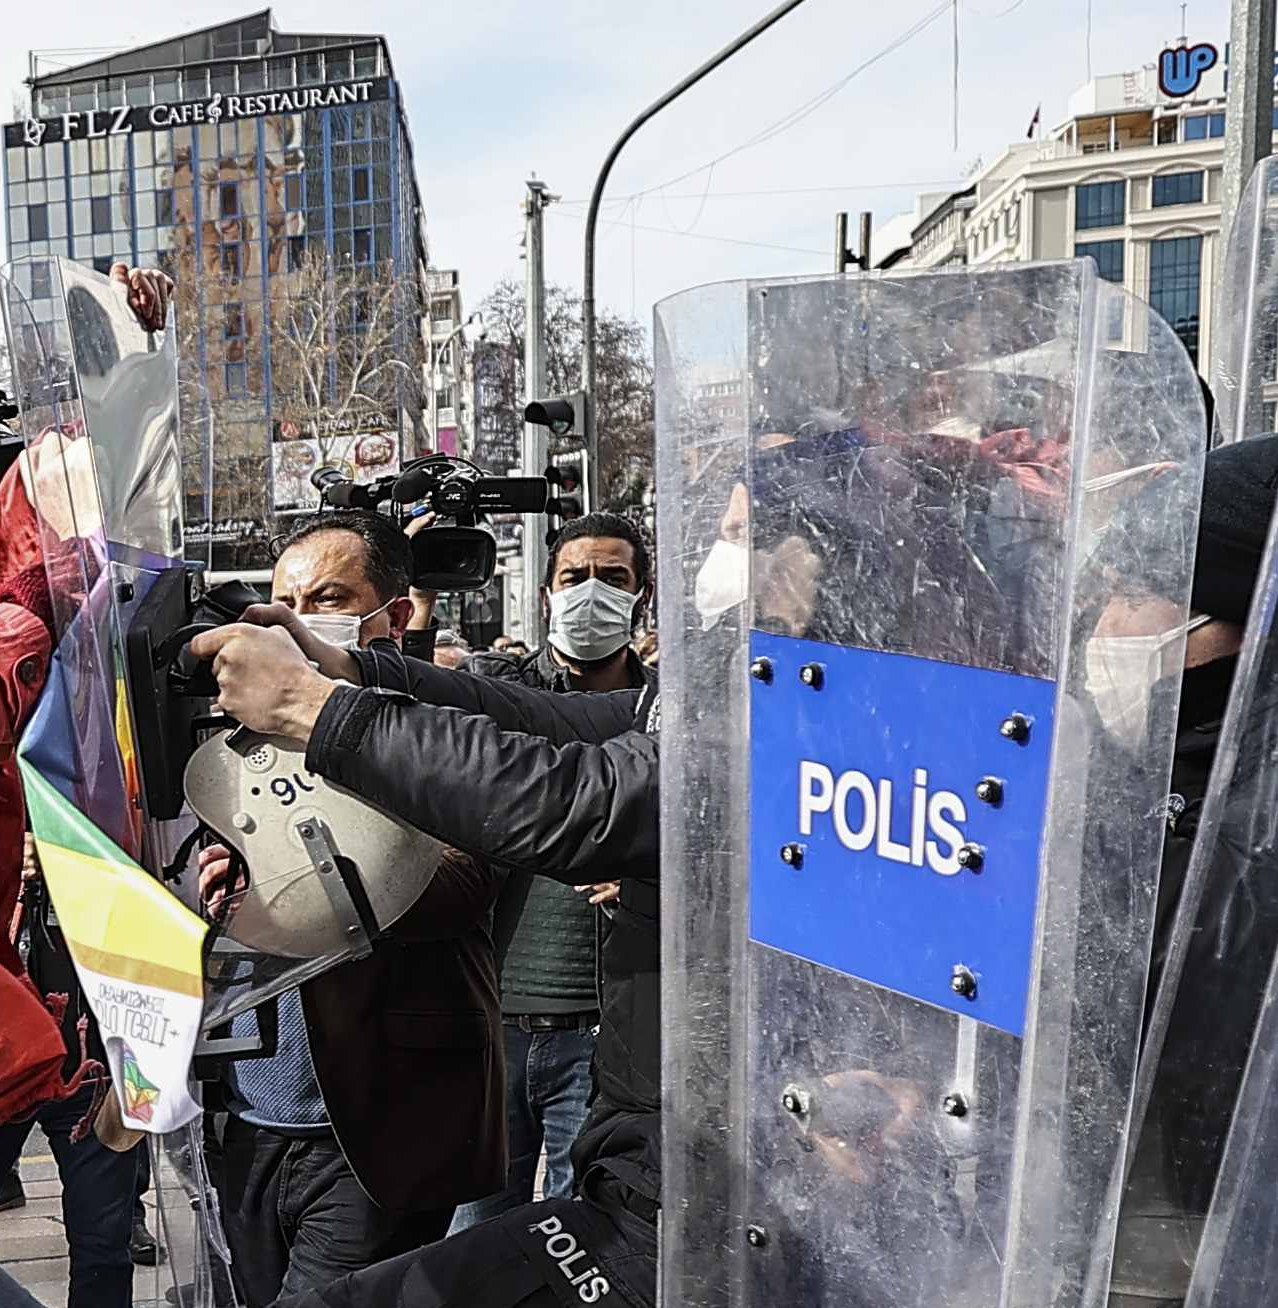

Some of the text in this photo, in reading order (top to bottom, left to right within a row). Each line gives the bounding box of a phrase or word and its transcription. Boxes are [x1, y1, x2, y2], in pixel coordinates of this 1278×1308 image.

[61, 82, 373, 140] FLZ CAFE RESTAURANT
[798, 760, 967, 876] POLİS
[534, 1215, 610, 1303] POLİS
